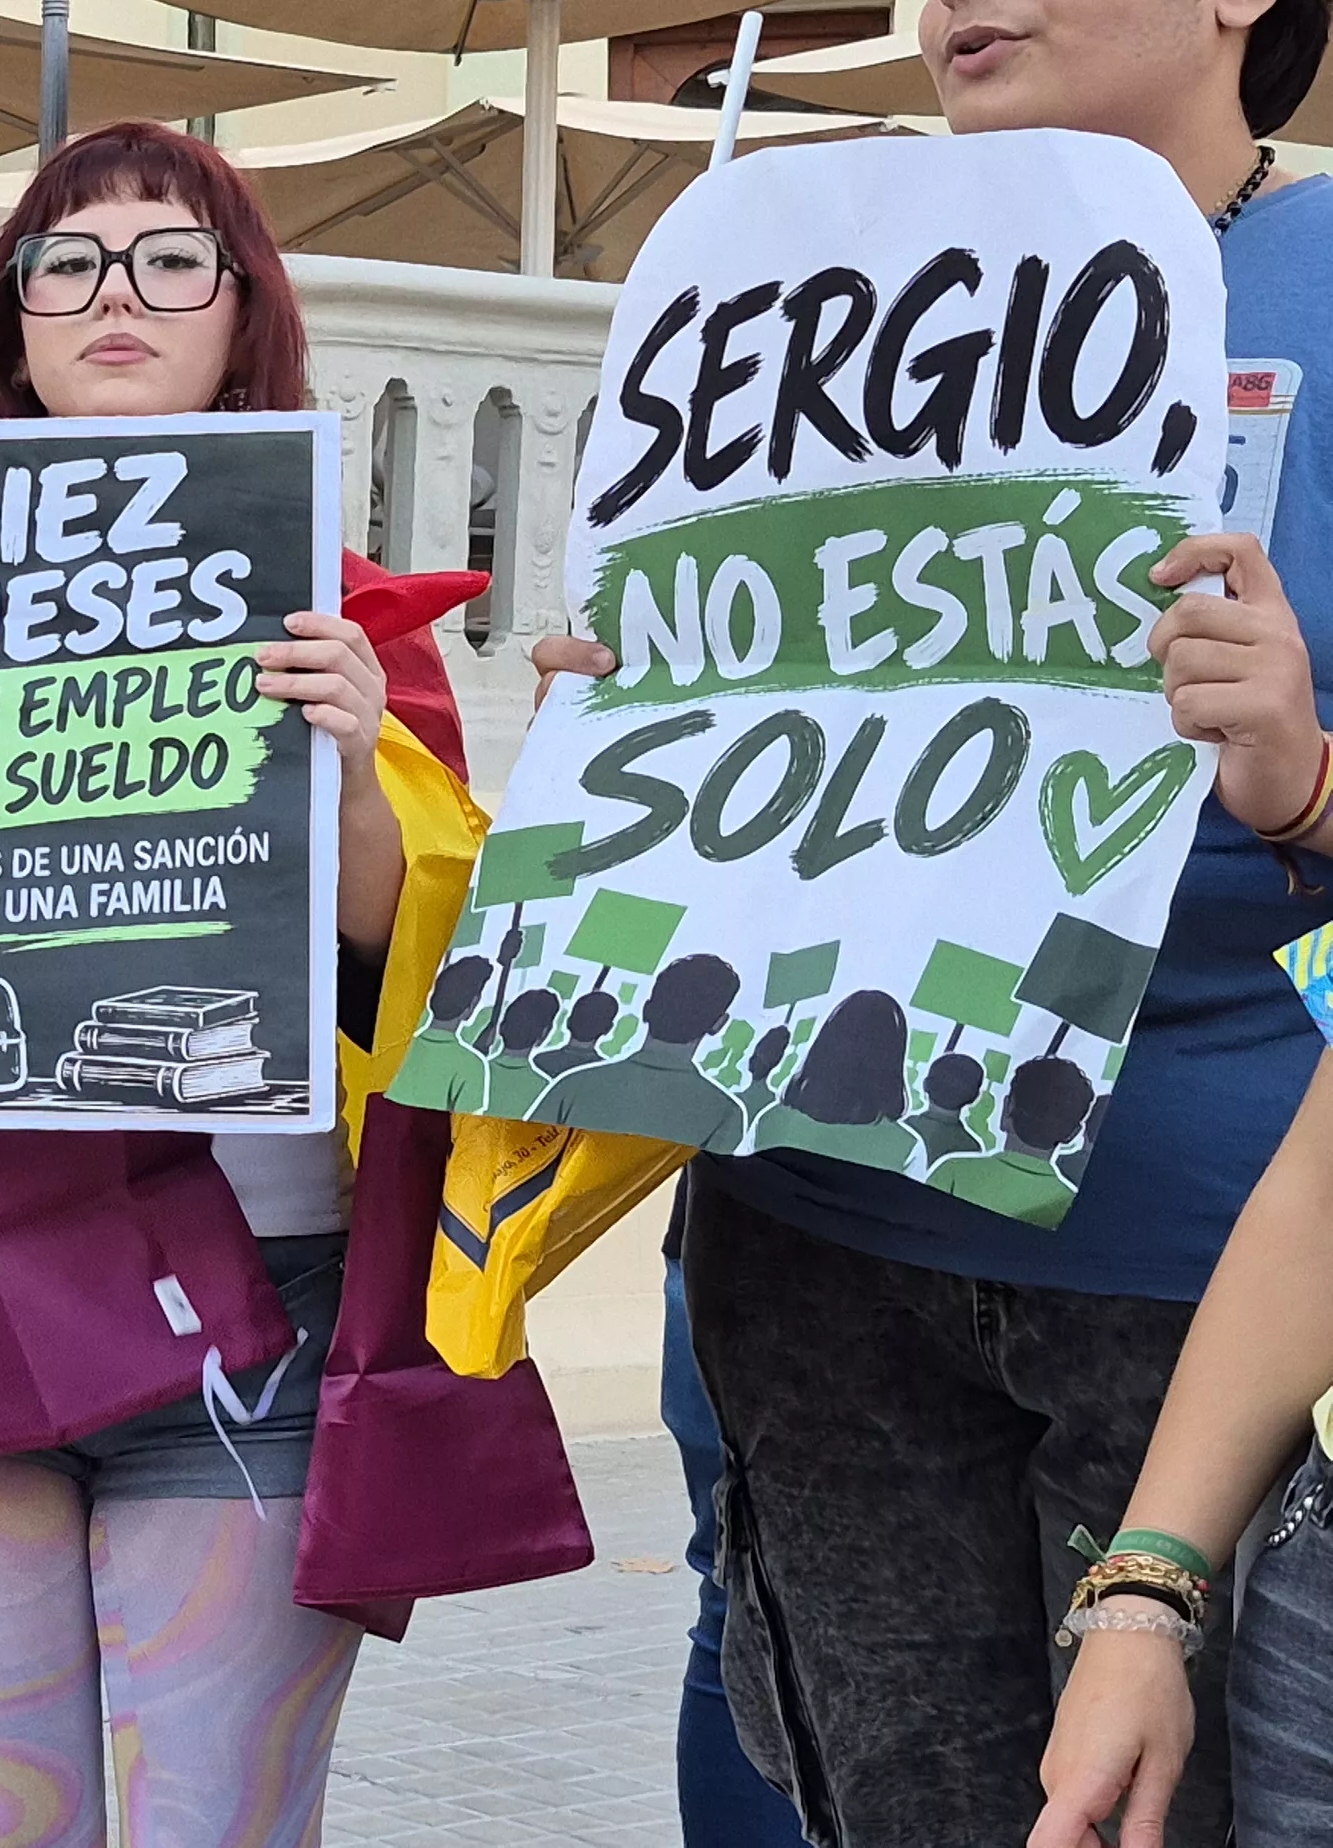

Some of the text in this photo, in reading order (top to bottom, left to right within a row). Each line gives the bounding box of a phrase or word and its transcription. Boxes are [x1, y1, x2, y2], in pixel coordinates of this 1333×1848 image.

[586, 240, 1197, 528] SERGIO,
[614, 489, 1164, 689] NO ESTÁS
[19, 655, 261, 736] EMPLEO
[5, 730, 229, 815] SUELDO
[546, 697, 1031, 881] SOLO
[12, 846, 53, 879] DE
[60, 843, 124, 874] UNA
[133, 826, 270, 872] SANCIÓN
[4, 888, 79, 923] UNA
[90, 877, 226, 919] FAMILIA
